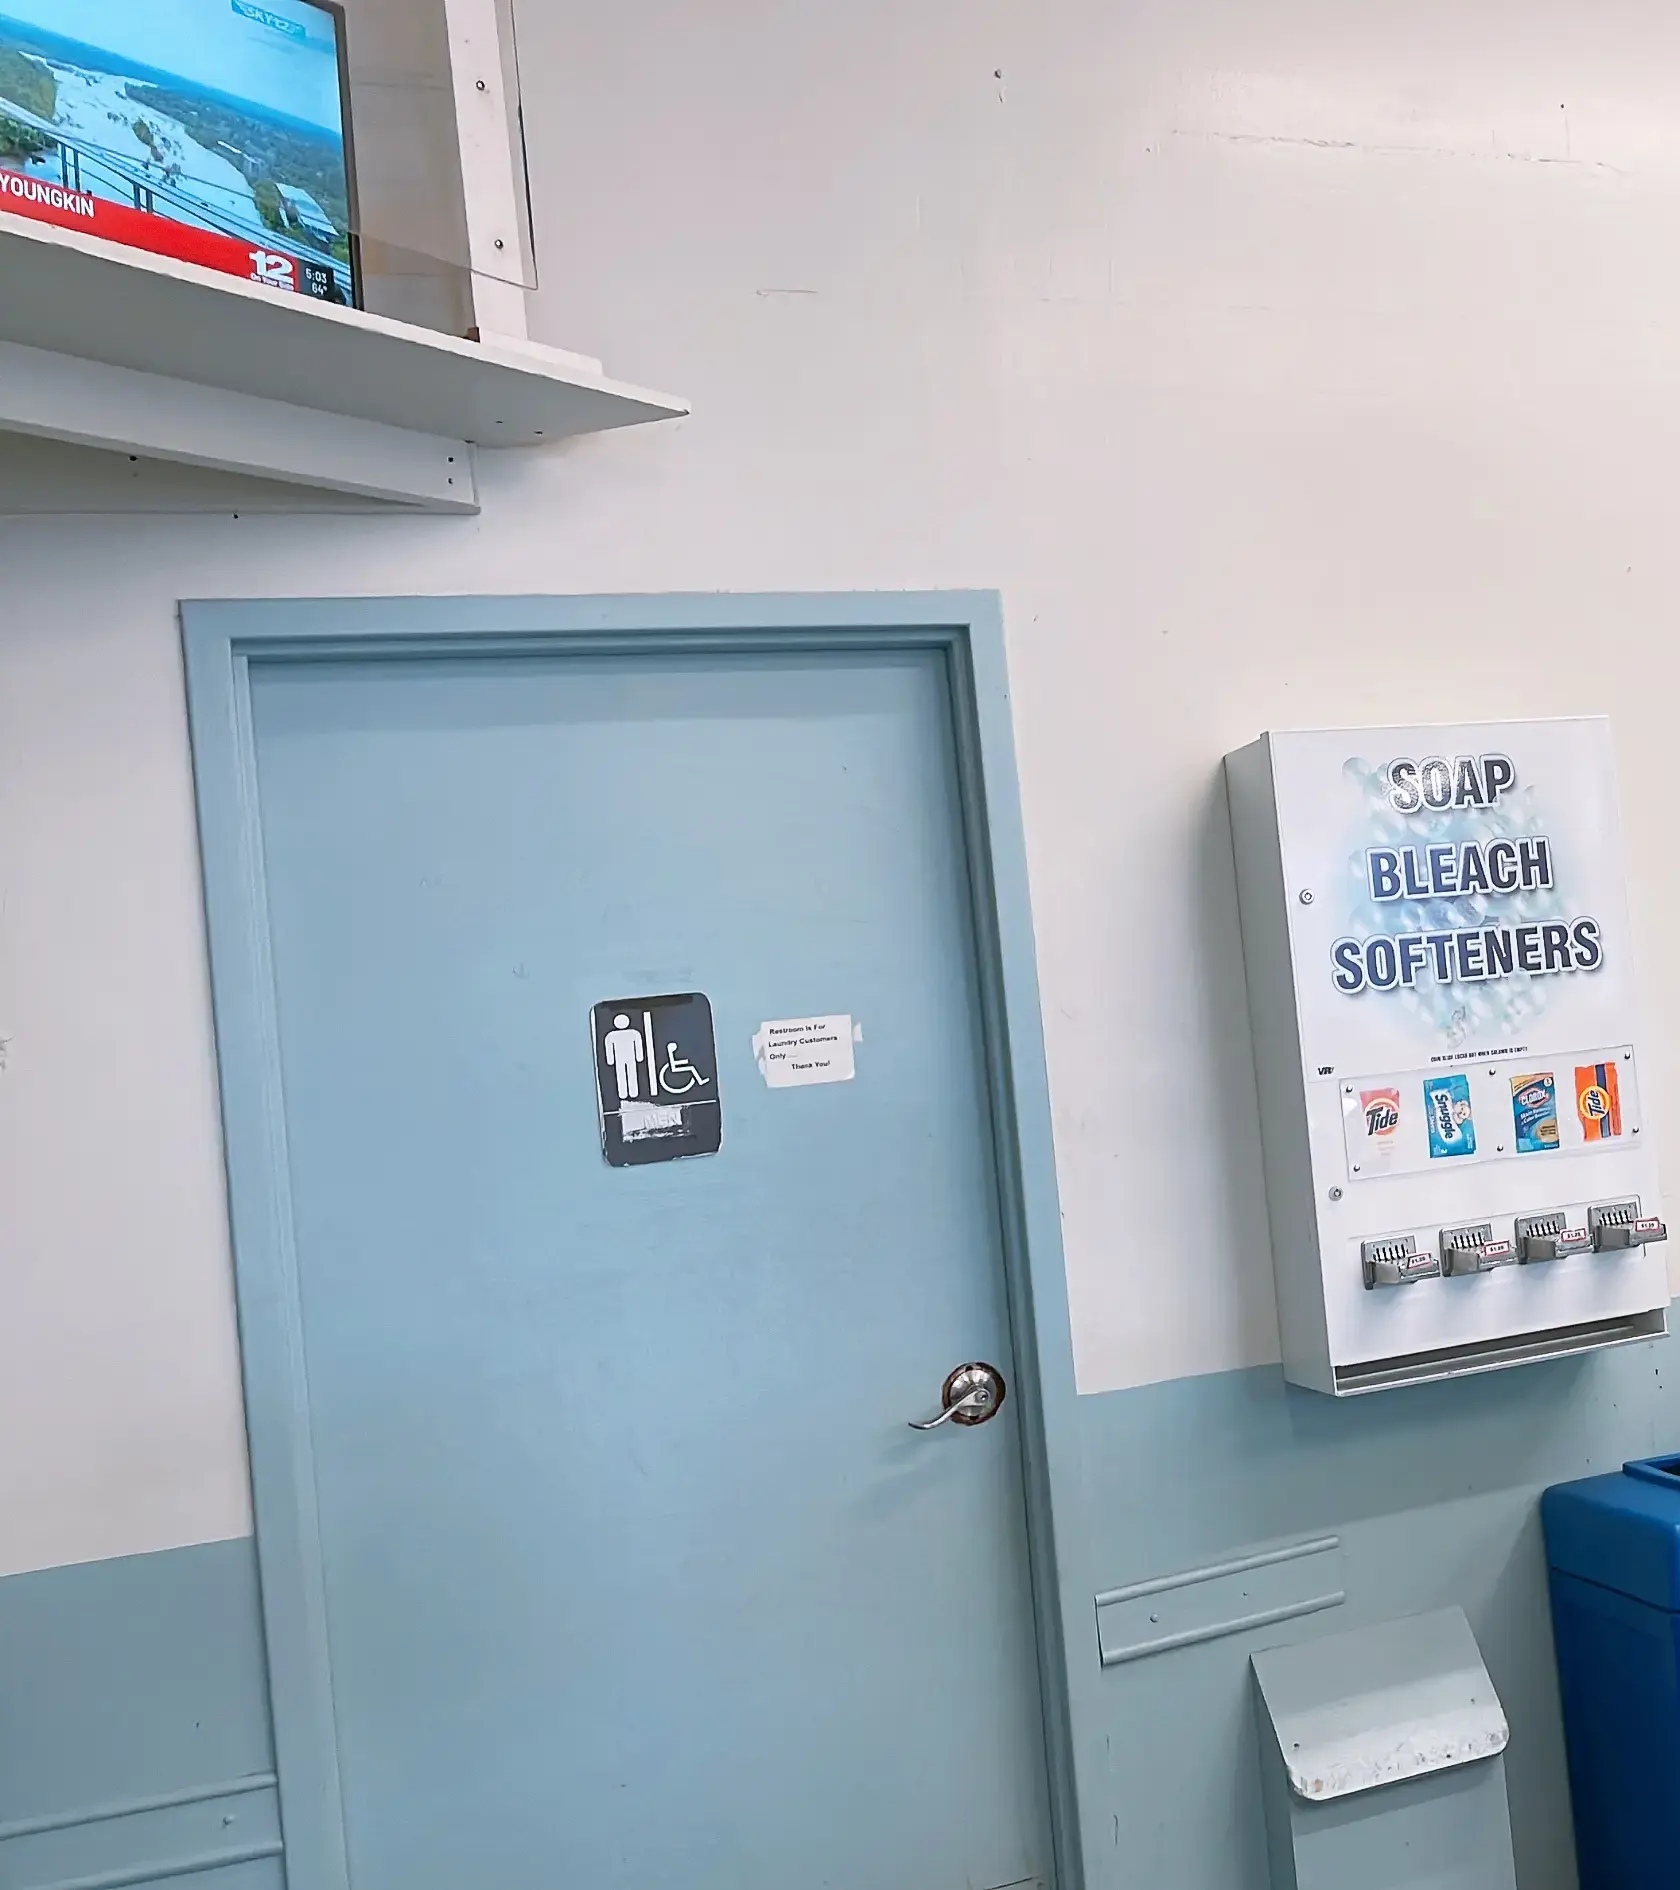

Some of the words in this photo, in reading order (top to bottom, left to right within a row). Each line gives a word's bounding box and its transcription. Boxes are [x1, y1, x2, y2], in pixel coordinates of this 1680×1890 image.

[0, 174, 95, 218] YOUNGKIN
[249, 250, 294, 285] 12
[306, 268, 327, 284] 5:03
[1387, 754, 1515, 814] SOAP
[1366, 836, 1554, 901] BLEACH
[1330, 916, 1602, 994] SOFTENERS
[768, 1040, 798, 1048] Laundry
[799, 1036, 838, 1045] Customers
[770, 1027, 804, 1035] Restroom
[769, 1053, 787, 1061] Only
[1435, 1094, 1456, 1139] Snuggle
[1588, 1090, 1605, 1117] Tide
[644, 1110, 681, 1129] MEN
[1366, 1106, 1399, 1136] Tide
